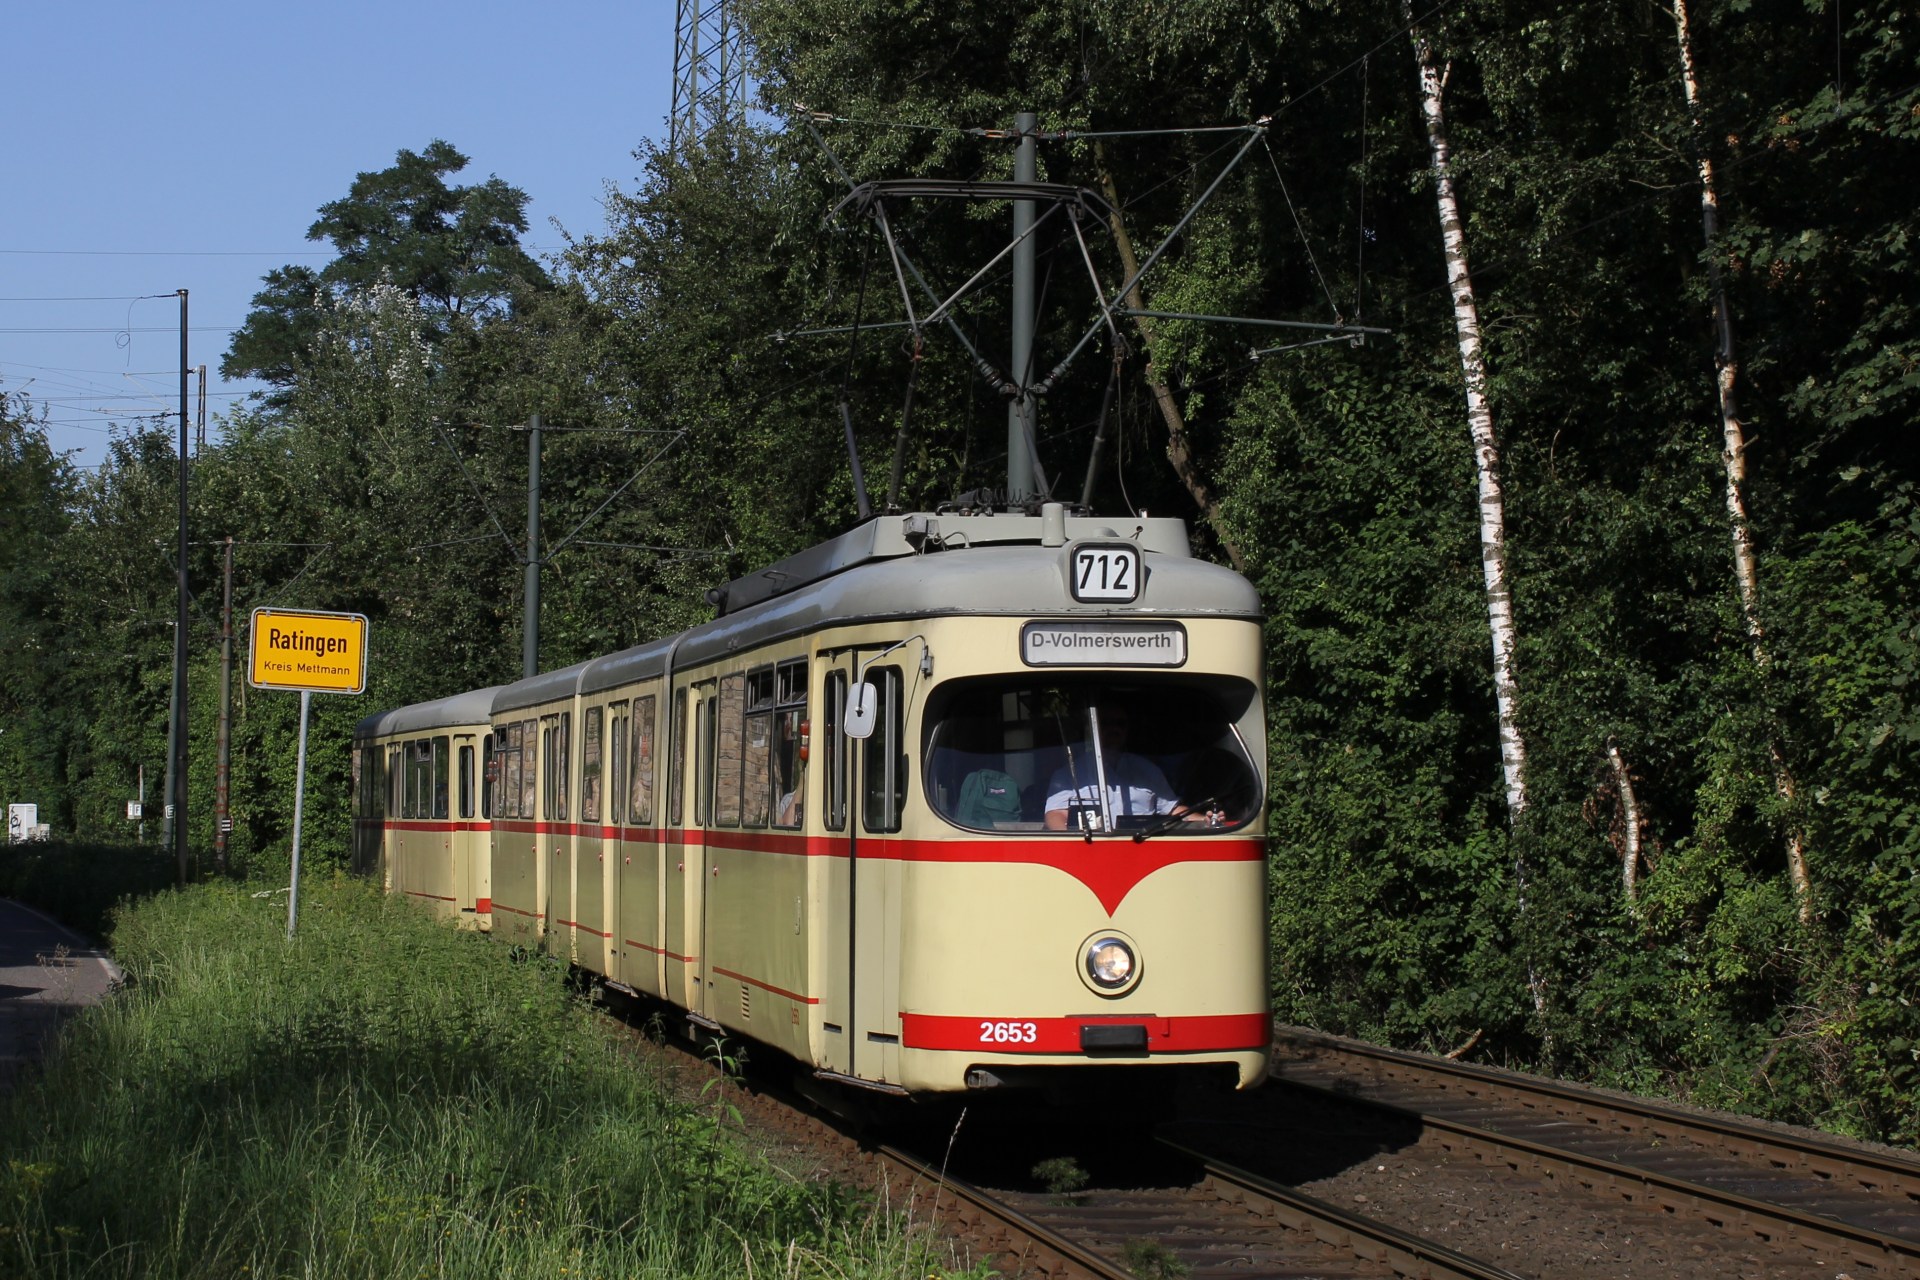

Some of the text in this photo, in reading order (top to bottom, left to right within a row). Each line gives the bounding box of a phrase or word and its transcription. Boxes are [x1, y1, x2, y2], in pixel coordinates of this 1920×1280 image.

[1079, 554, 1129, 590] 712
[269, 628, 347, 657] Ratingen
[1031, 632, 1171, 648] D-Volmerswerth
[264, 661, 350, 675] Kreis Mettmann
[980, 1021, 1037, 1043] 2653
